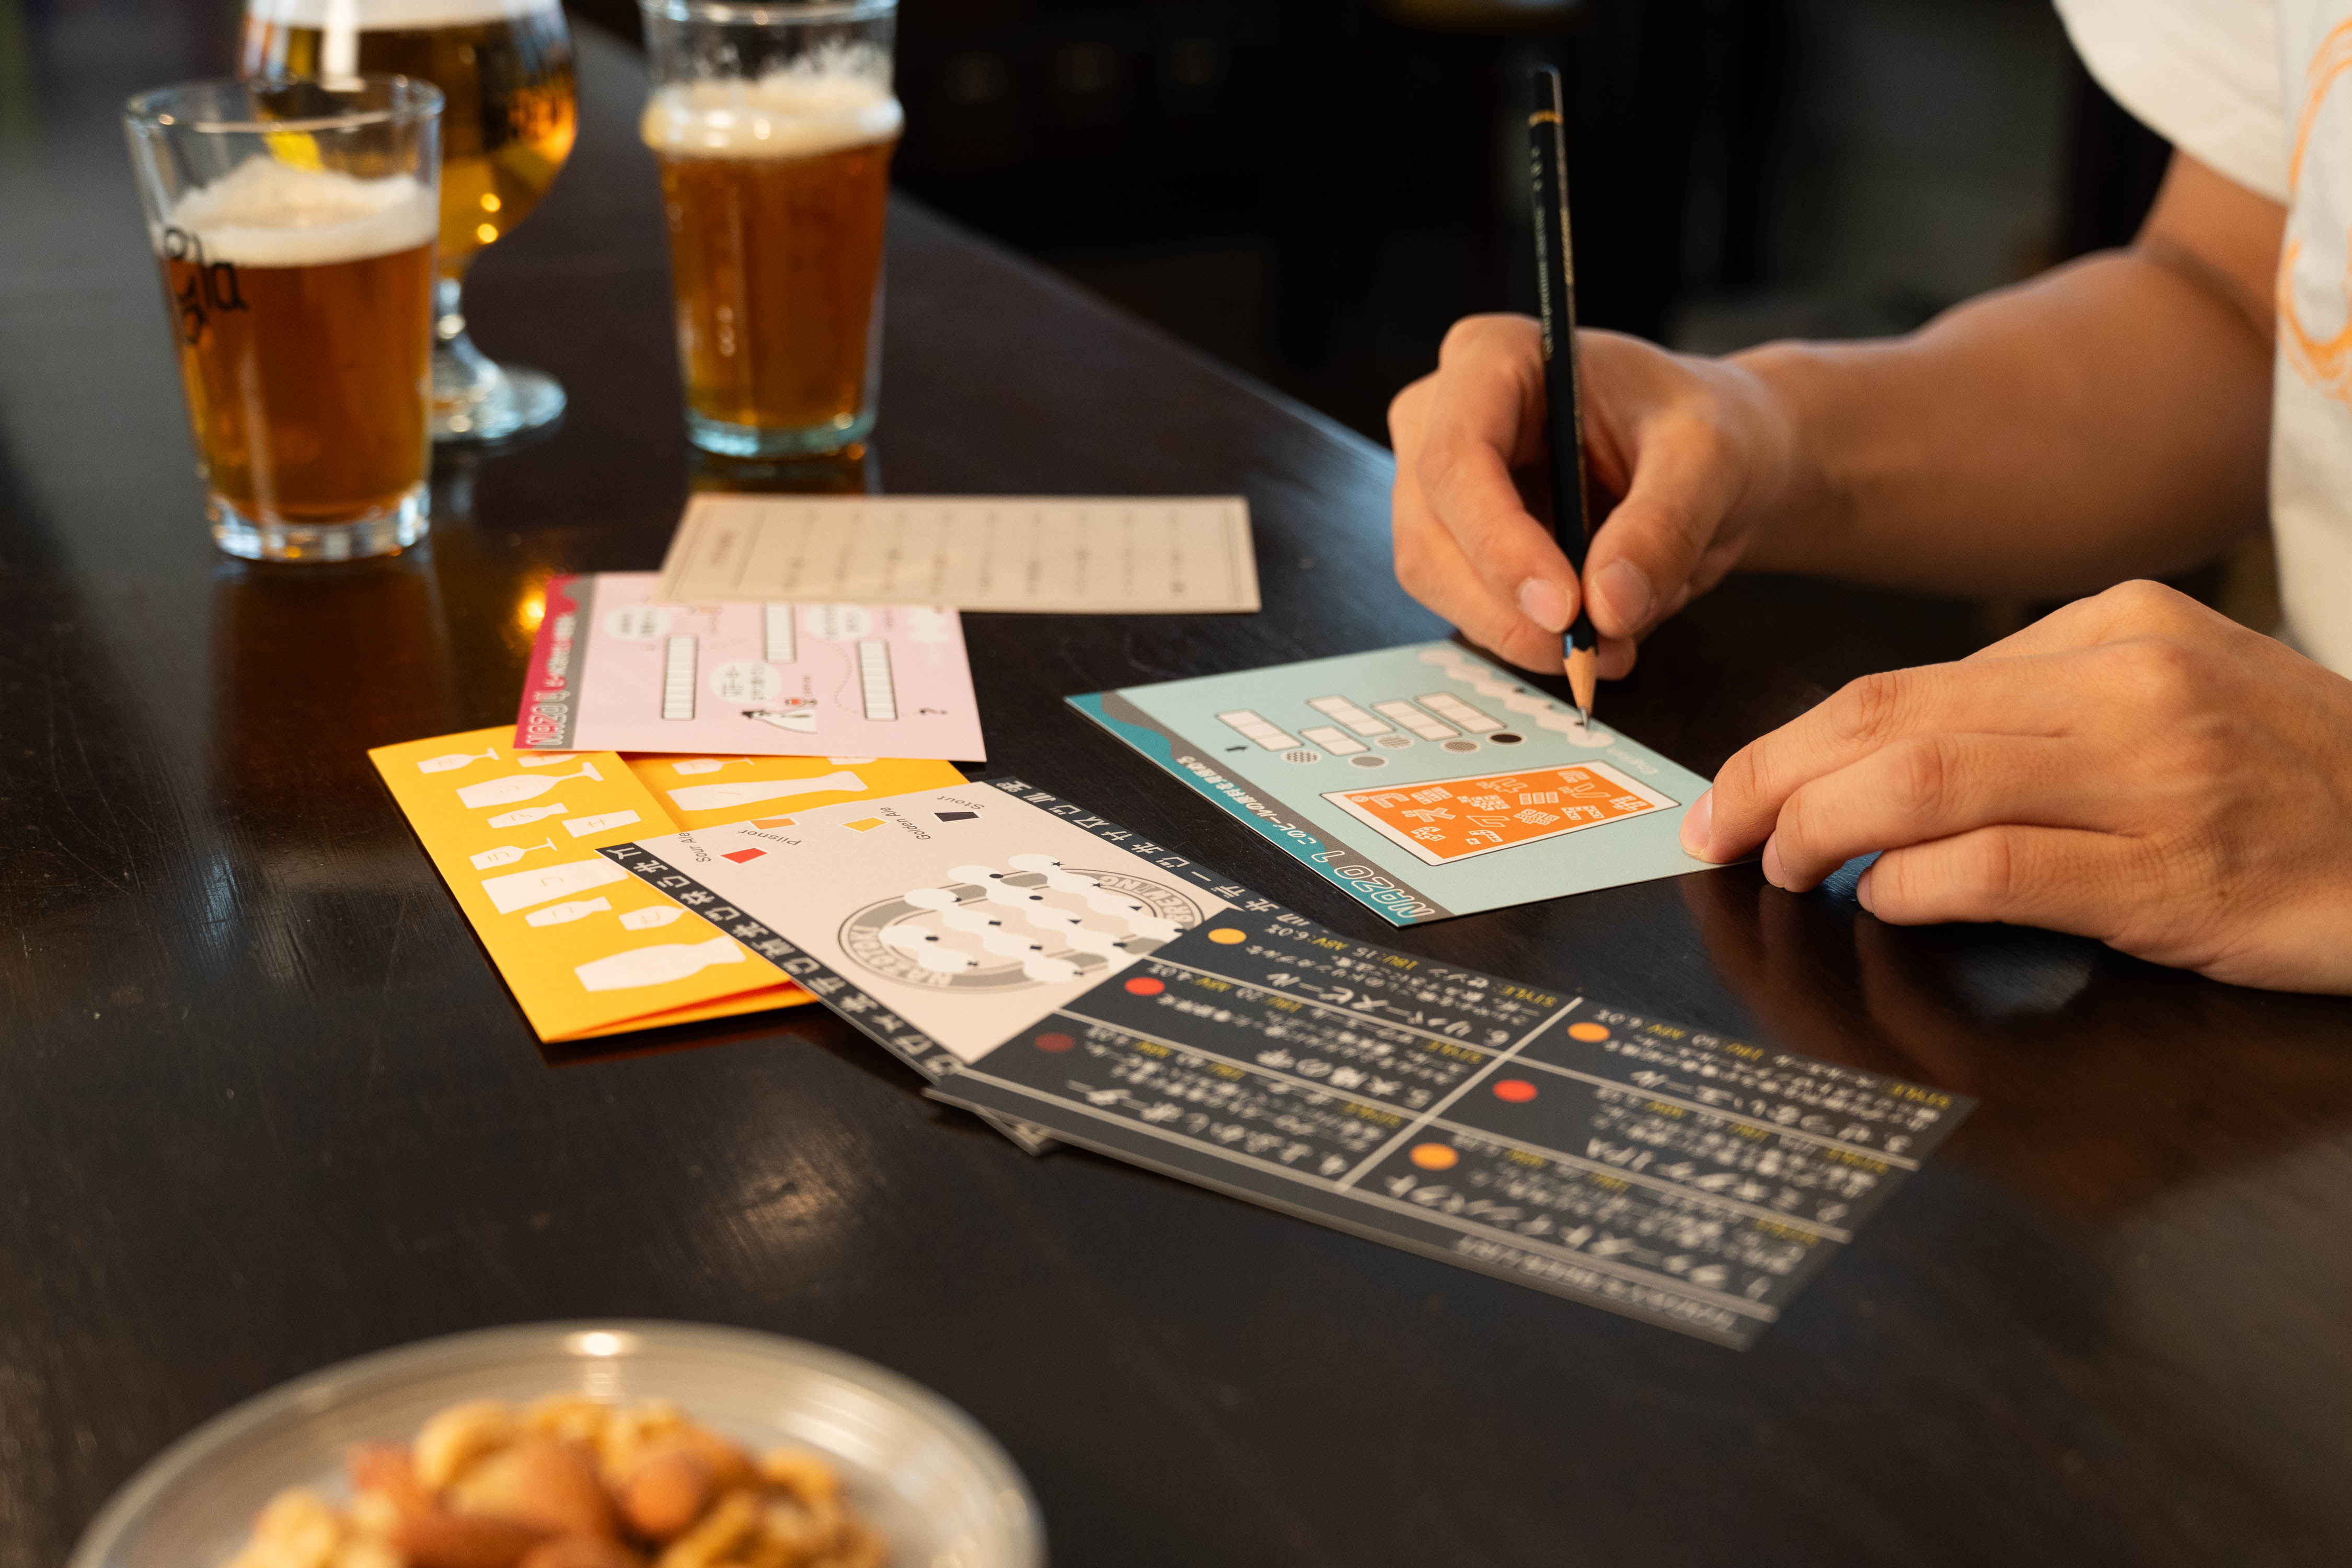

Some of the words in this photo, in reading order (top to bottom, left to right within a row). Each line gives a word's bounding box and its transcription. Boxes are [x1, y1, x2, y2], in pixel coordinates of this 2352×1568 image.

[936, 795, 985, 810] Stout
[880, 806, 902, 823] Ale
[737, 829, 802, 845] Pilsner
[896, 817, 931, 840] Golden
[678, 832, 697, 845] Ale
[690, 845, 711, 863] Sour
[1311, 850, 1345, 863] 1
[1100, 876, 1195, 922] BREWING
[1334, 865, 1435, 918] NAZO
